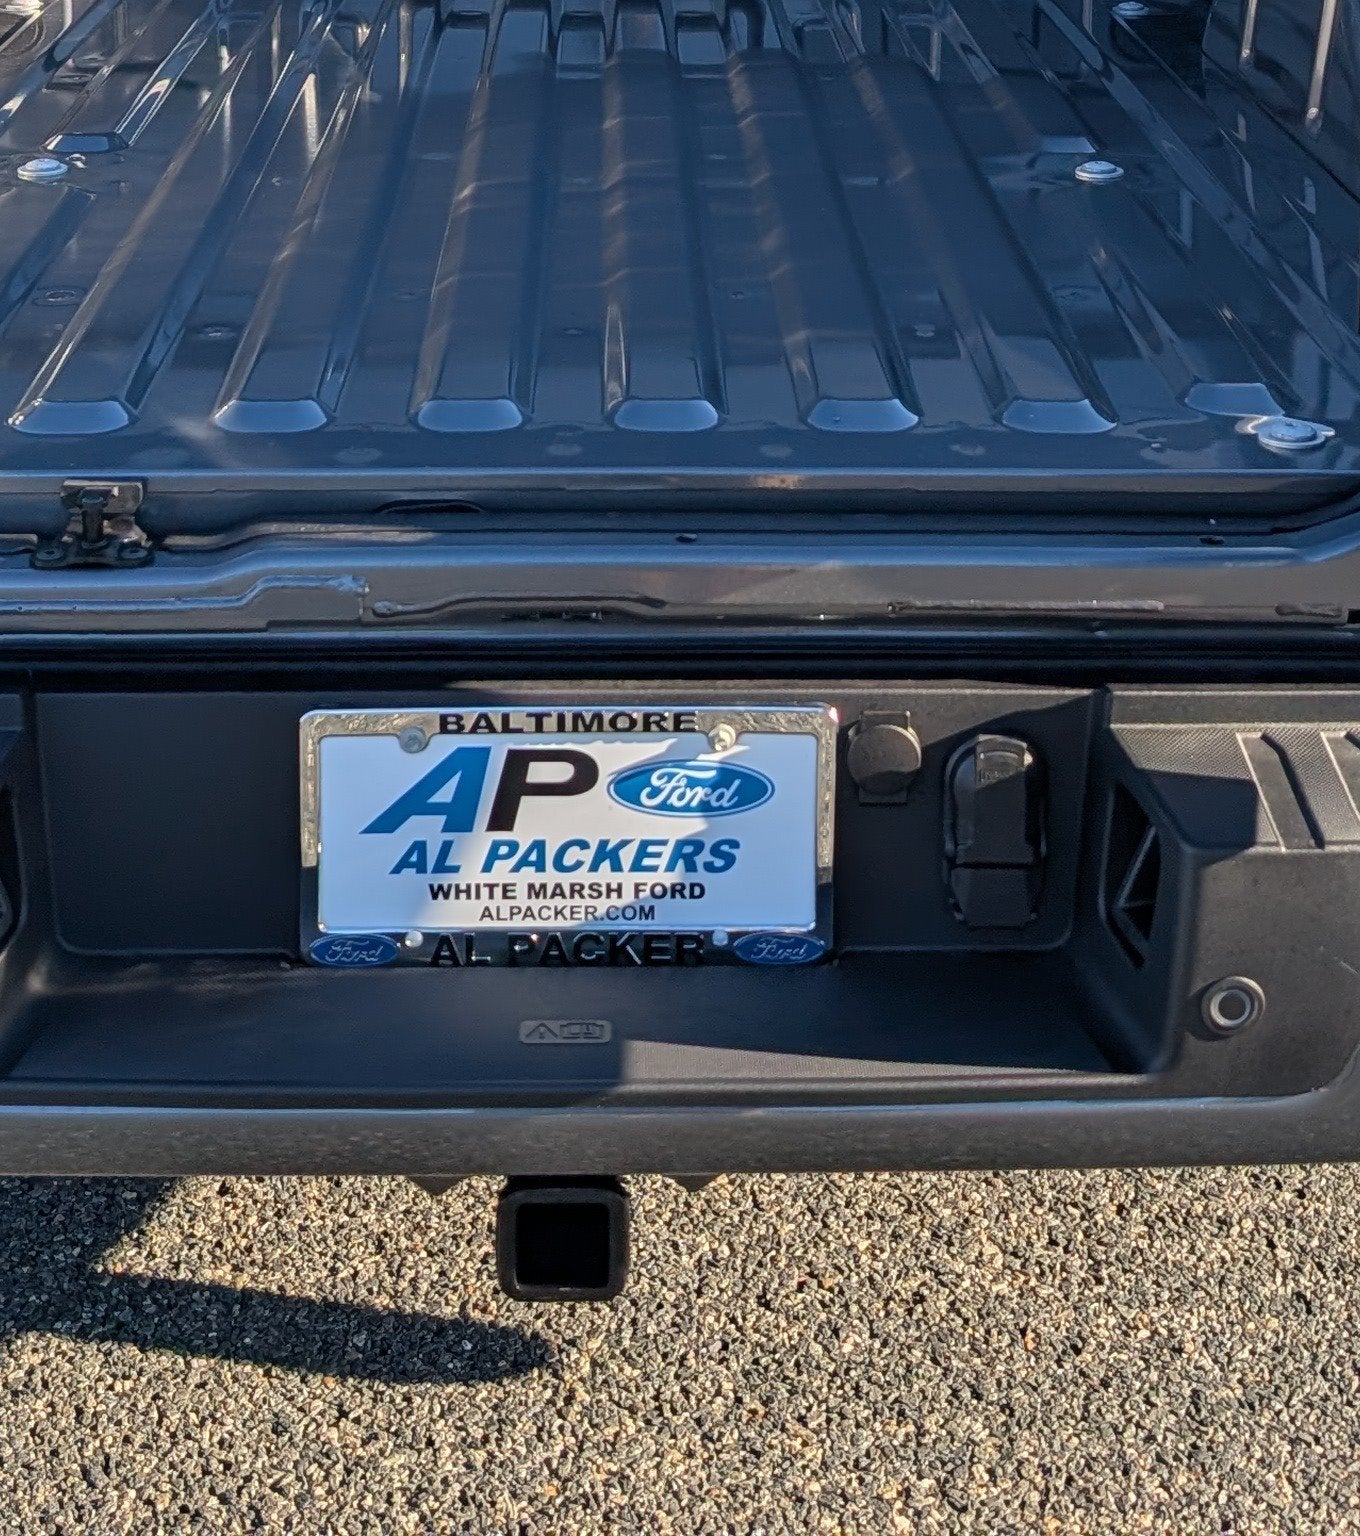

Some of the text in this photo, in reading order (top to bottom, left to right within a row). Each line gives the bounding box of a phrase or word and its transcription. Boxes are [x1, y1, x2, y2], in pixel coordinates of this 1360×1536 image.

[439, 711, 698, 734] BALTIMORE
[359, 745, 599, 834] AP
[639, 766, 742, 810] Ford
[388, 837, 742, 875] AL PACKERS
[428, 881, 707, 900] WHITE MARSH FORD
[478, 904, 657, 922] ALPACKER.COM
[430, 931, 706, 966] AL PACKER
